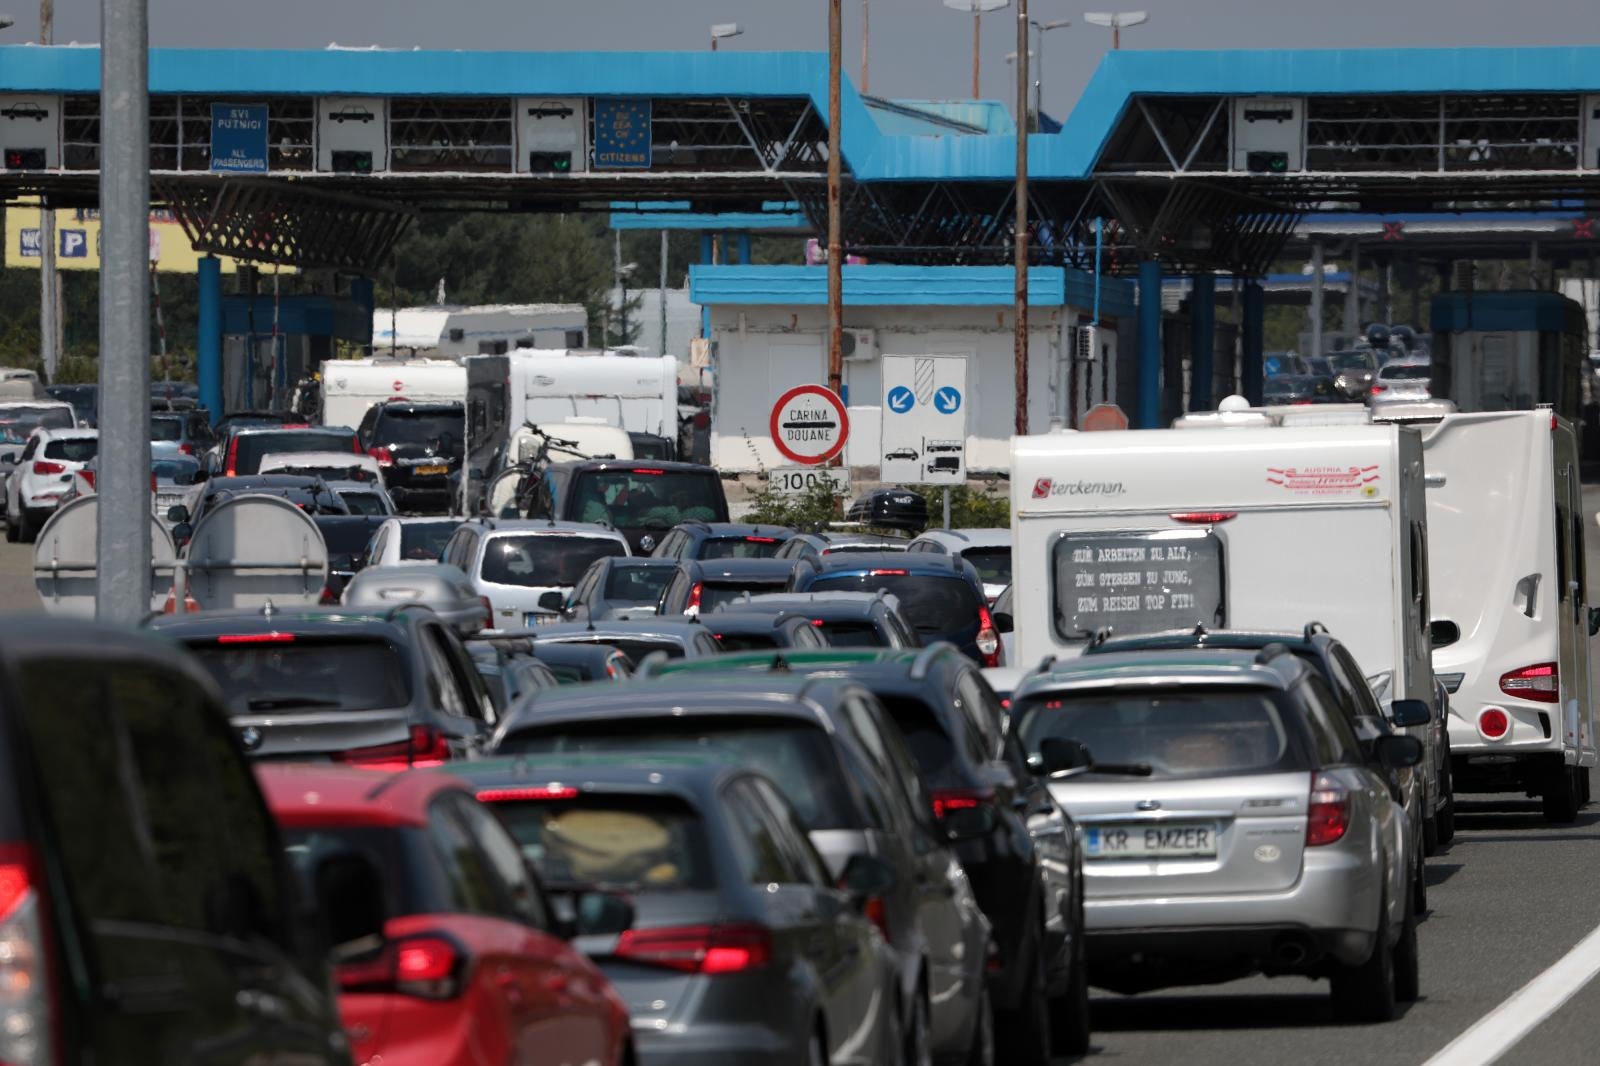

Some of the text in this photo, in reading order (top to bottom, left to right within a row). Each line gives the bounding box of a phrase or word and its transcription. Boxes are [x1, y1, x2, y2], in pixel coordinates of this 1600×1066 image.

[231, 109, 249, 119] SVI
[231, 149, 247, 159] ALL
[600, 152, 646, 163] CITIZENS
[213, 158, 265, 169] PASSENGERS
[789, 409, 828, 421] CARINA
[787, 429, 832, 441] DOUANE
[1032, 478, 1126, 498] Sterckeman
[1073, 549, 1093, 563] ZUM
[1098, 547, 1146, 562] ARBEITEN
[1150, 547, 1165, 561] ZU
[1076, 570, 1193, 587] ZUM STERBEN ZU JUNG,
[1077, 597, 1098, 612] ZUM
[1103, 595, 1140, 612] REISEN
[1145, 595, 1165, 610] TOP
[1102, 828, 1210, 850] KR EMZER
